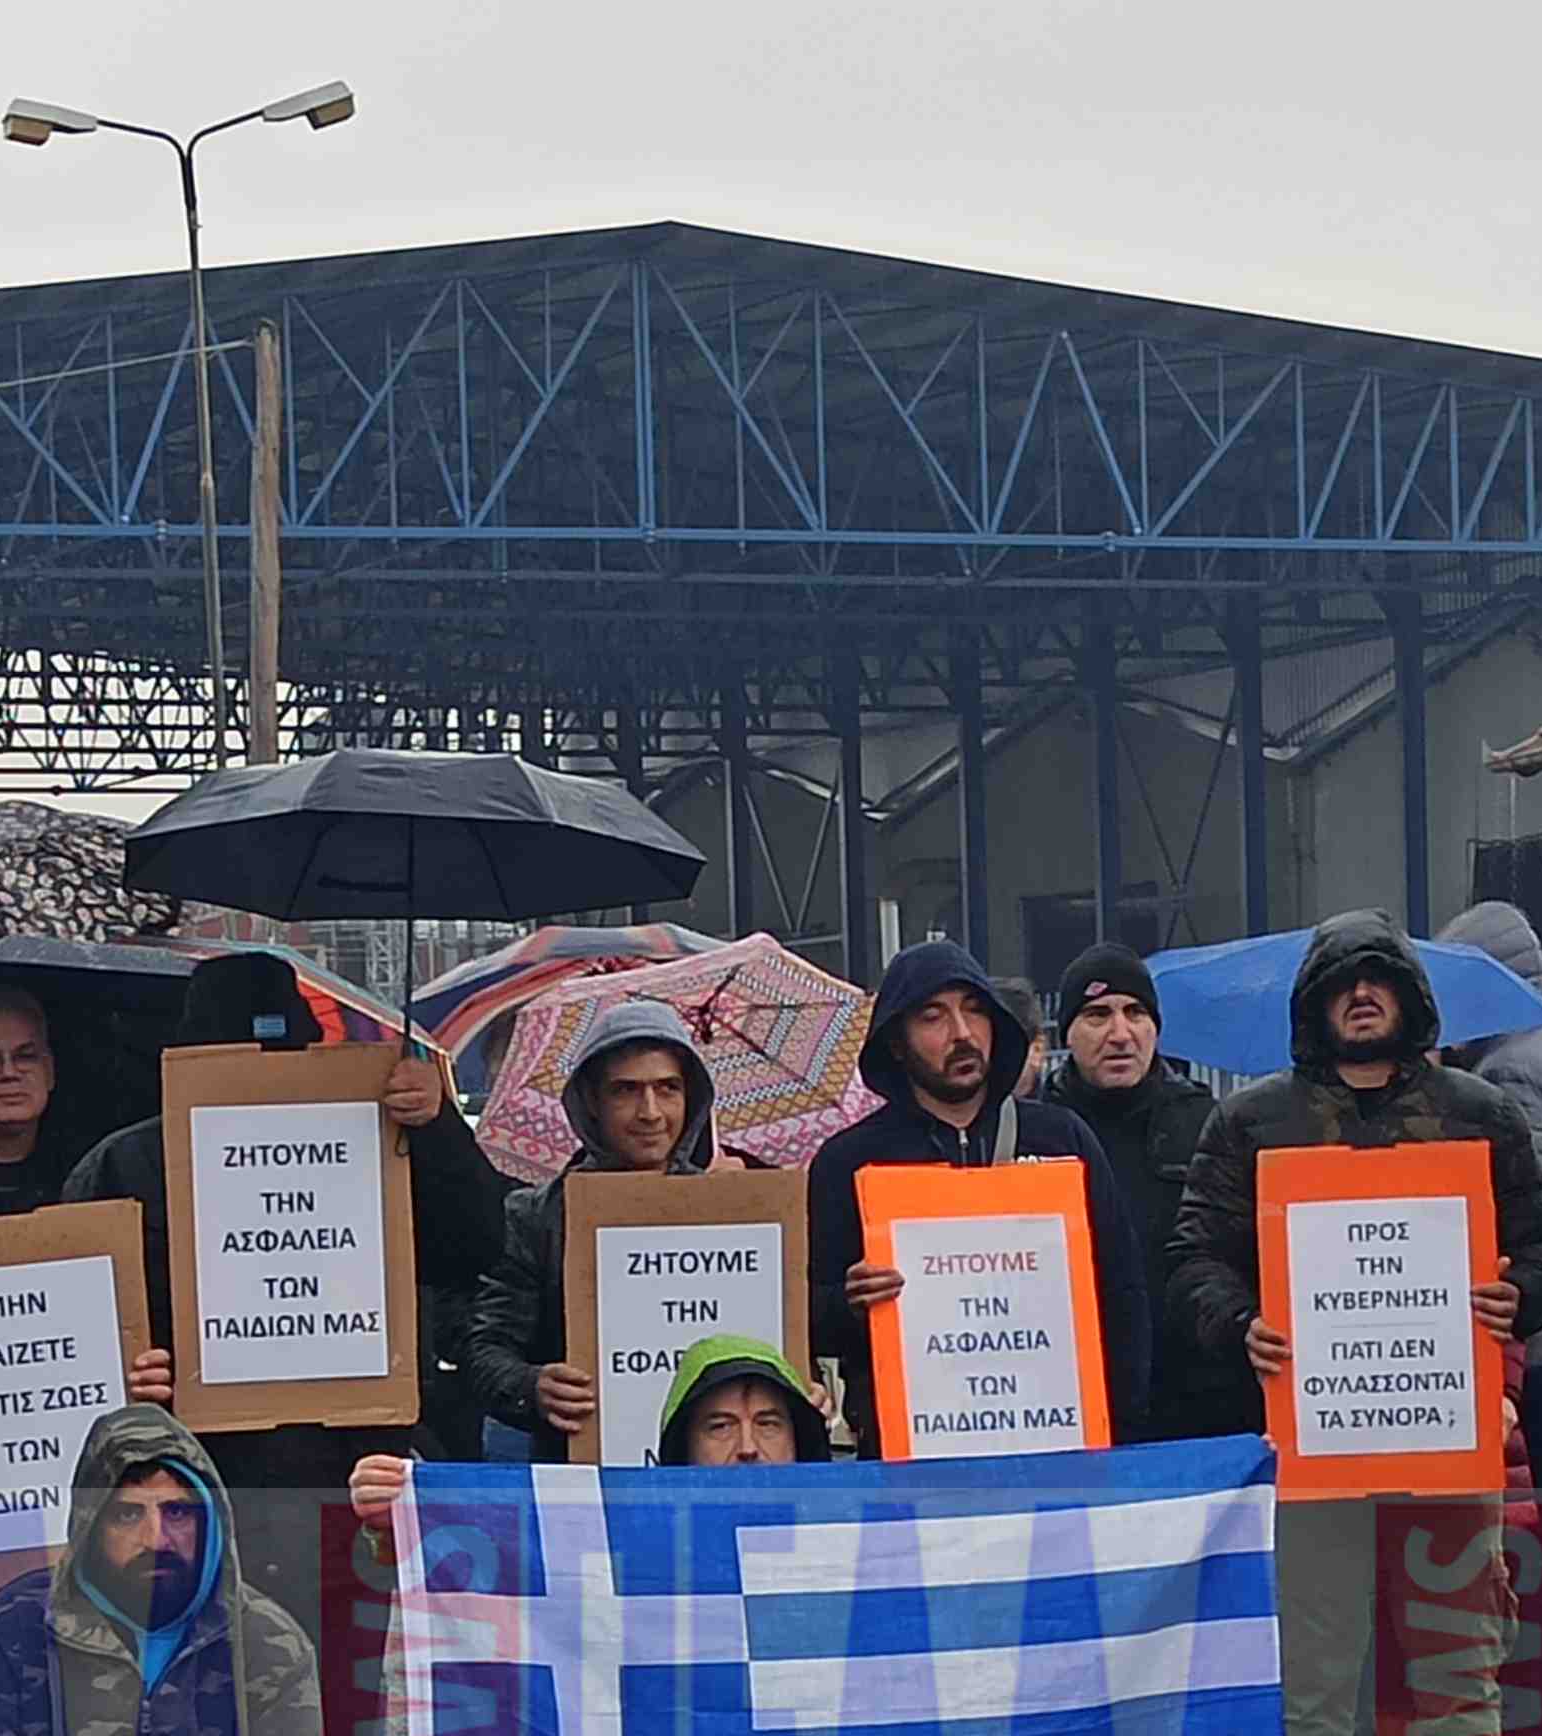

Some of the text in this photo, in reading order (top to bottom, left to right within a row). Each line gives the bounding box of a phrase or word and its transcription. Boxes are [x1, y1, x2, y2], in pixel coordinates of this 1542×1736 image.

[224, 1142, 348, 1168] ΖΗΤΟΥΜΕ
[260, 1191, 314, 1214] ΤΗΝ
[222, 1227, 356, 1253] ΑΣΦΑΛΕΙΑ
[1348, 1222, 1410, 1242] ΠΡΟΣ
[628, 1250, 758, 1275] ΖΗΤΟΥΜΕ
[922, 1251, 1039, 1275] ΖΗΤΟΥΜΕ
[1355, 1256, 1403, 1275] ΤΗΝ
[263, 1276, 318, 1299] ΤΩΝ
[959, 1296, 1009, 1317] ΤΗΝ
[1314, 1288, 1448, 1311] ΚΥΒΕΡΝΗΣΗ
[661, 1300, 718, 1323] ΤΗΝ
[205, 1311, 379, 1339] ΠΑΙΔΙΩΝ ΜΑΣ
[927, 1329, 1050, 1353] ΑΣΦΑΛΕΙΑ
[1331, 1339, 1435, 1361] ΓΙΑΤΙ ΔΕΝ
[966, 1375, 1017, 1396] ΤΩΝ
[1304, 1371, 1465, 1396] ΦΥΛΑΣΣΟΝΤΑΙ
[42, 1381, 109, 1410] ΖΩΕΣ
[913, 1407, 1077, 1434] ΠΑΙΔΙΩΝ ΜΑΣ
[1316, 1410, 1345, 1429] ΤΑ
[1350, 1406, 1441, 1429] ΣΥΝΟΡΑ
[2, 1437, 60, 1464] ΤΩΝ
